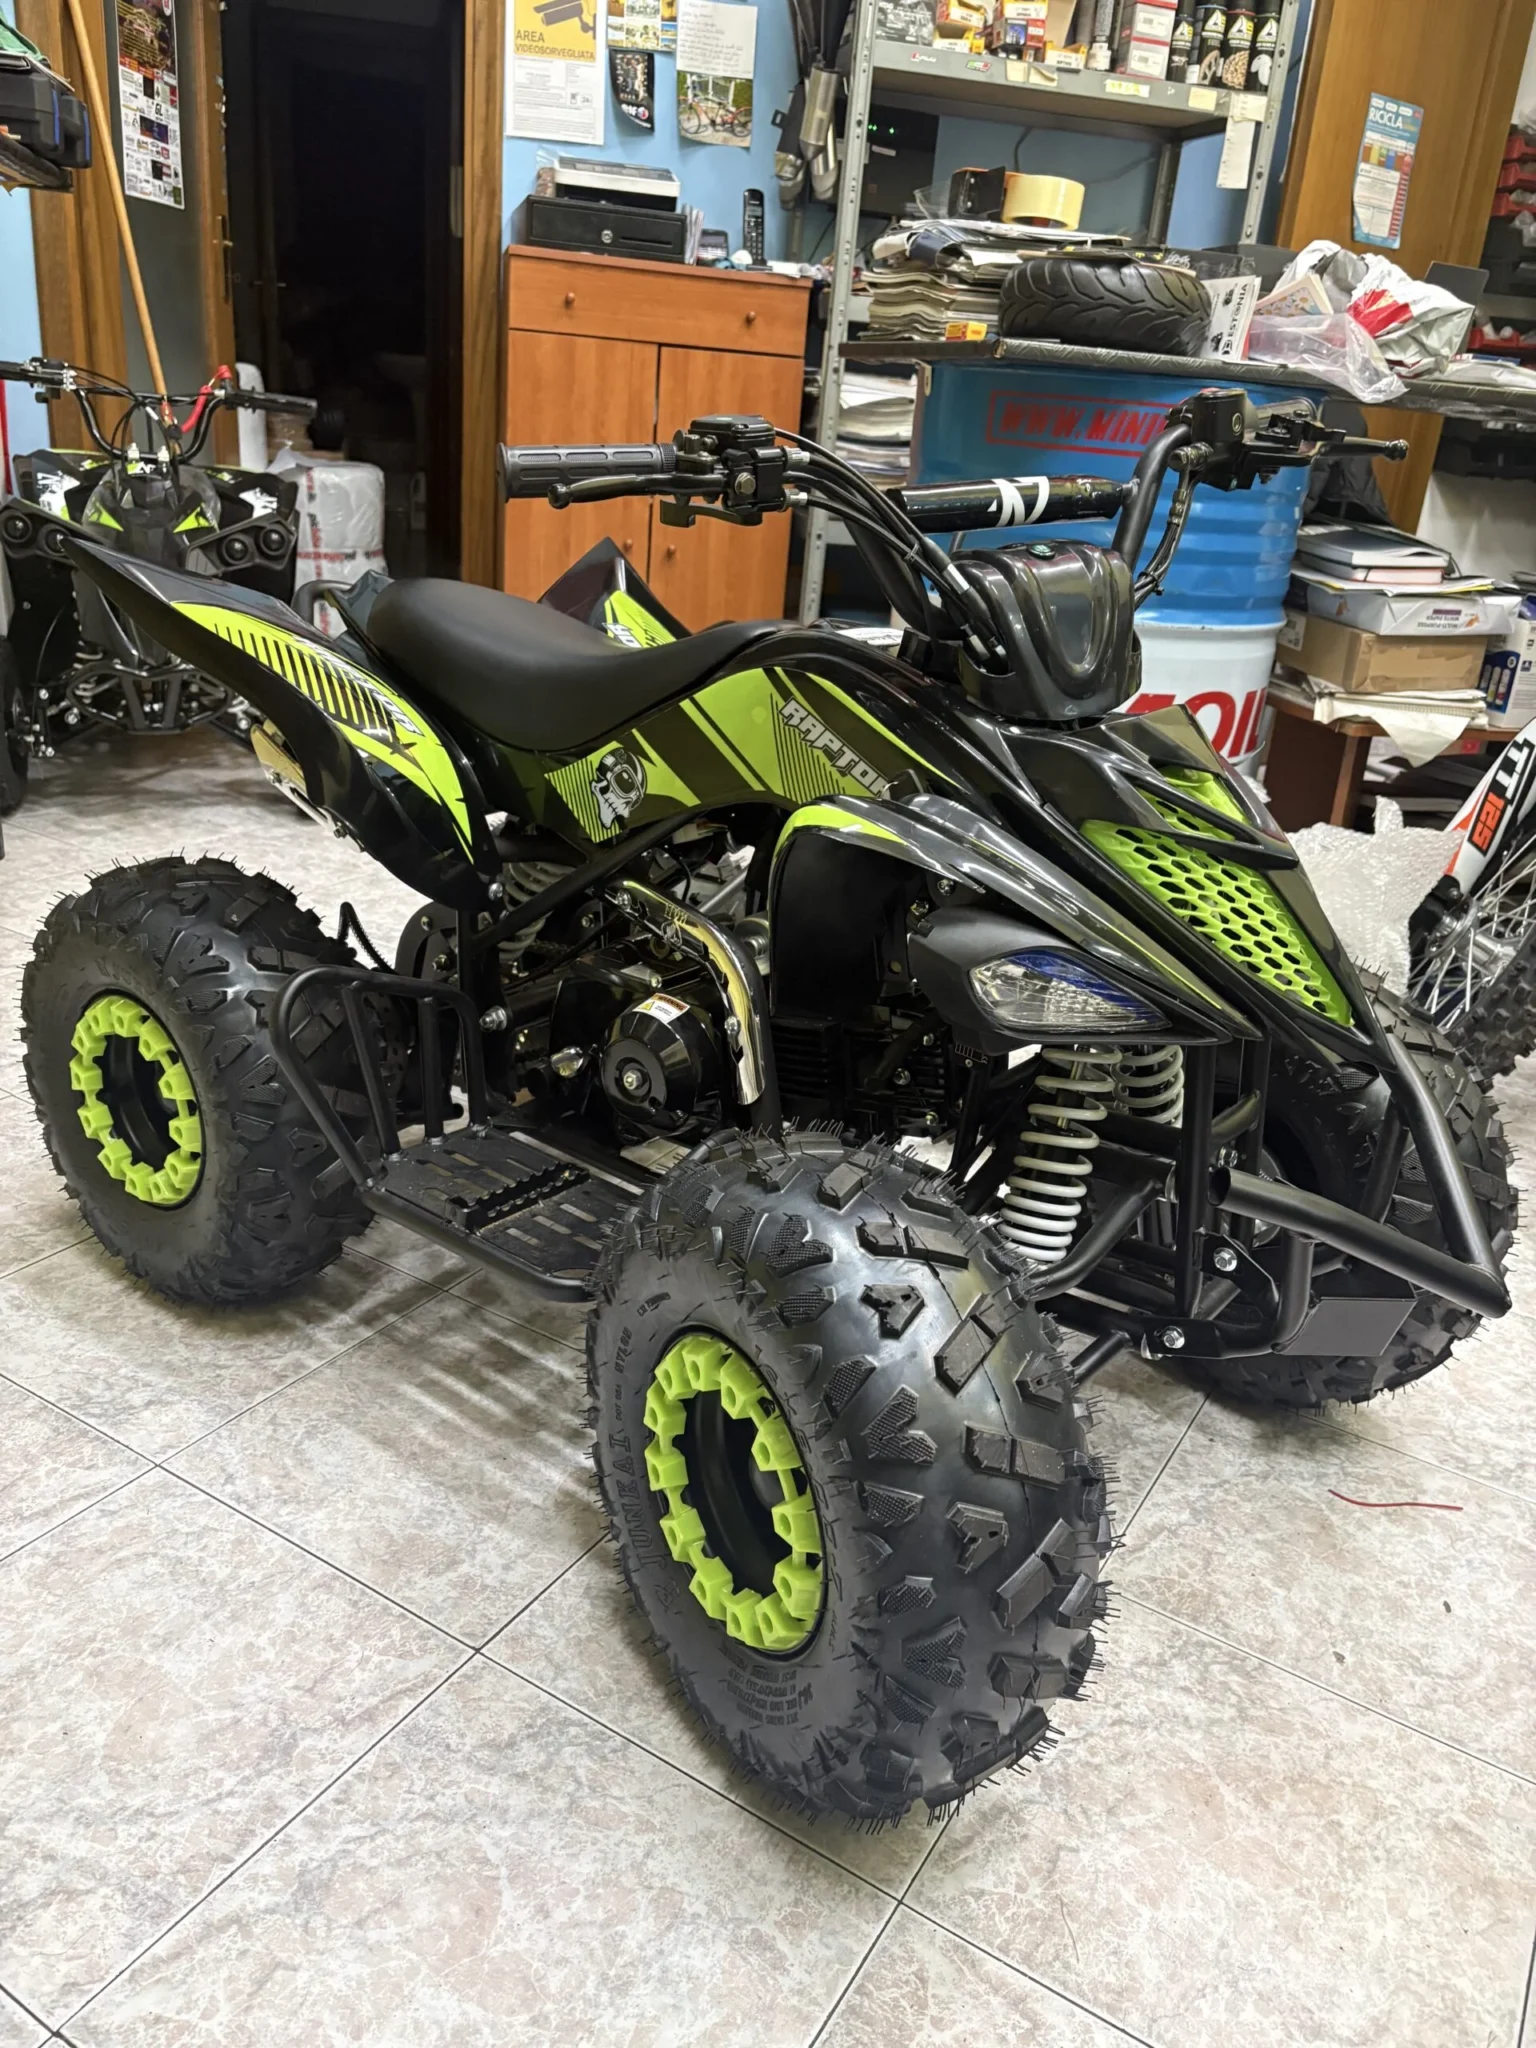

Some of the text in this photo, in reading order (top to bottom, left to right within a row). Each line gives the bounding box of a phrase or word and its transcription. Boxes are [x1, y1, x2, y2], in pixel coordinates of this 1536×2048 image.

[515, 29, 545, 43] AREA
[515, 43, 595, 60] VIDEOSORVEGLIATA
[1369, 107, 1403, 129] RICICLA
[1001, 402, 1169, 445] WWW.MINI
[609, 1433, 668, 1570] JUNKAI
